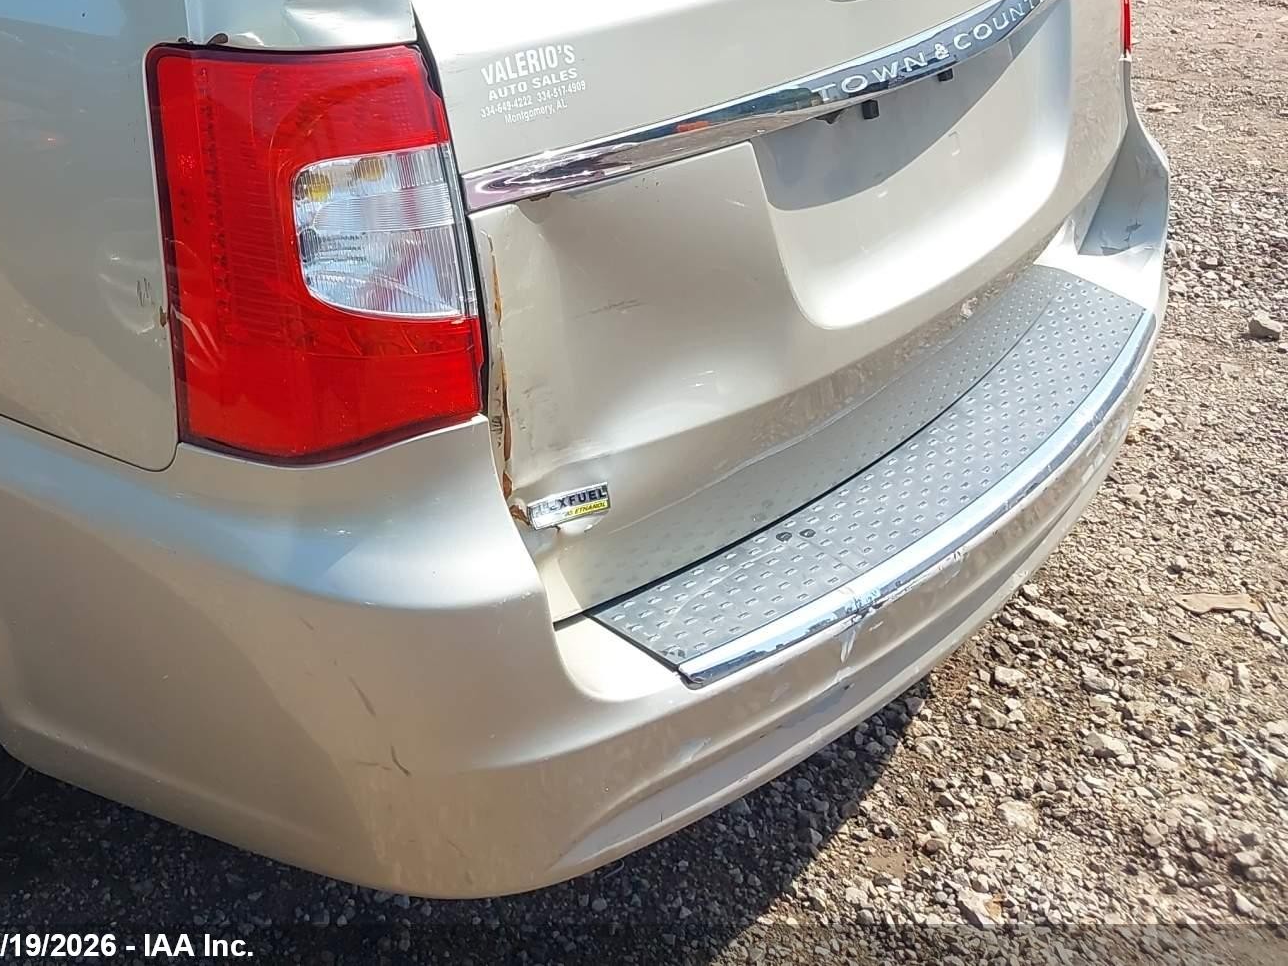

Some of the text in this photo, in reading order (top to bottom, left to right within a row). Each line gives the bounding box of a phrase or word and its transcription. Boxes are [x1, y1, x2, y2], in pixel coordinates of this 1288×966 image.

[480, 44, 576, 85] VALERIO'S
[811, 52, 928, 102] TOWN
[488, 67, 578, 101] AUTO SALES
[556, 97, 568, 111] AL
[533, 487, 607, 518] XFUEL
